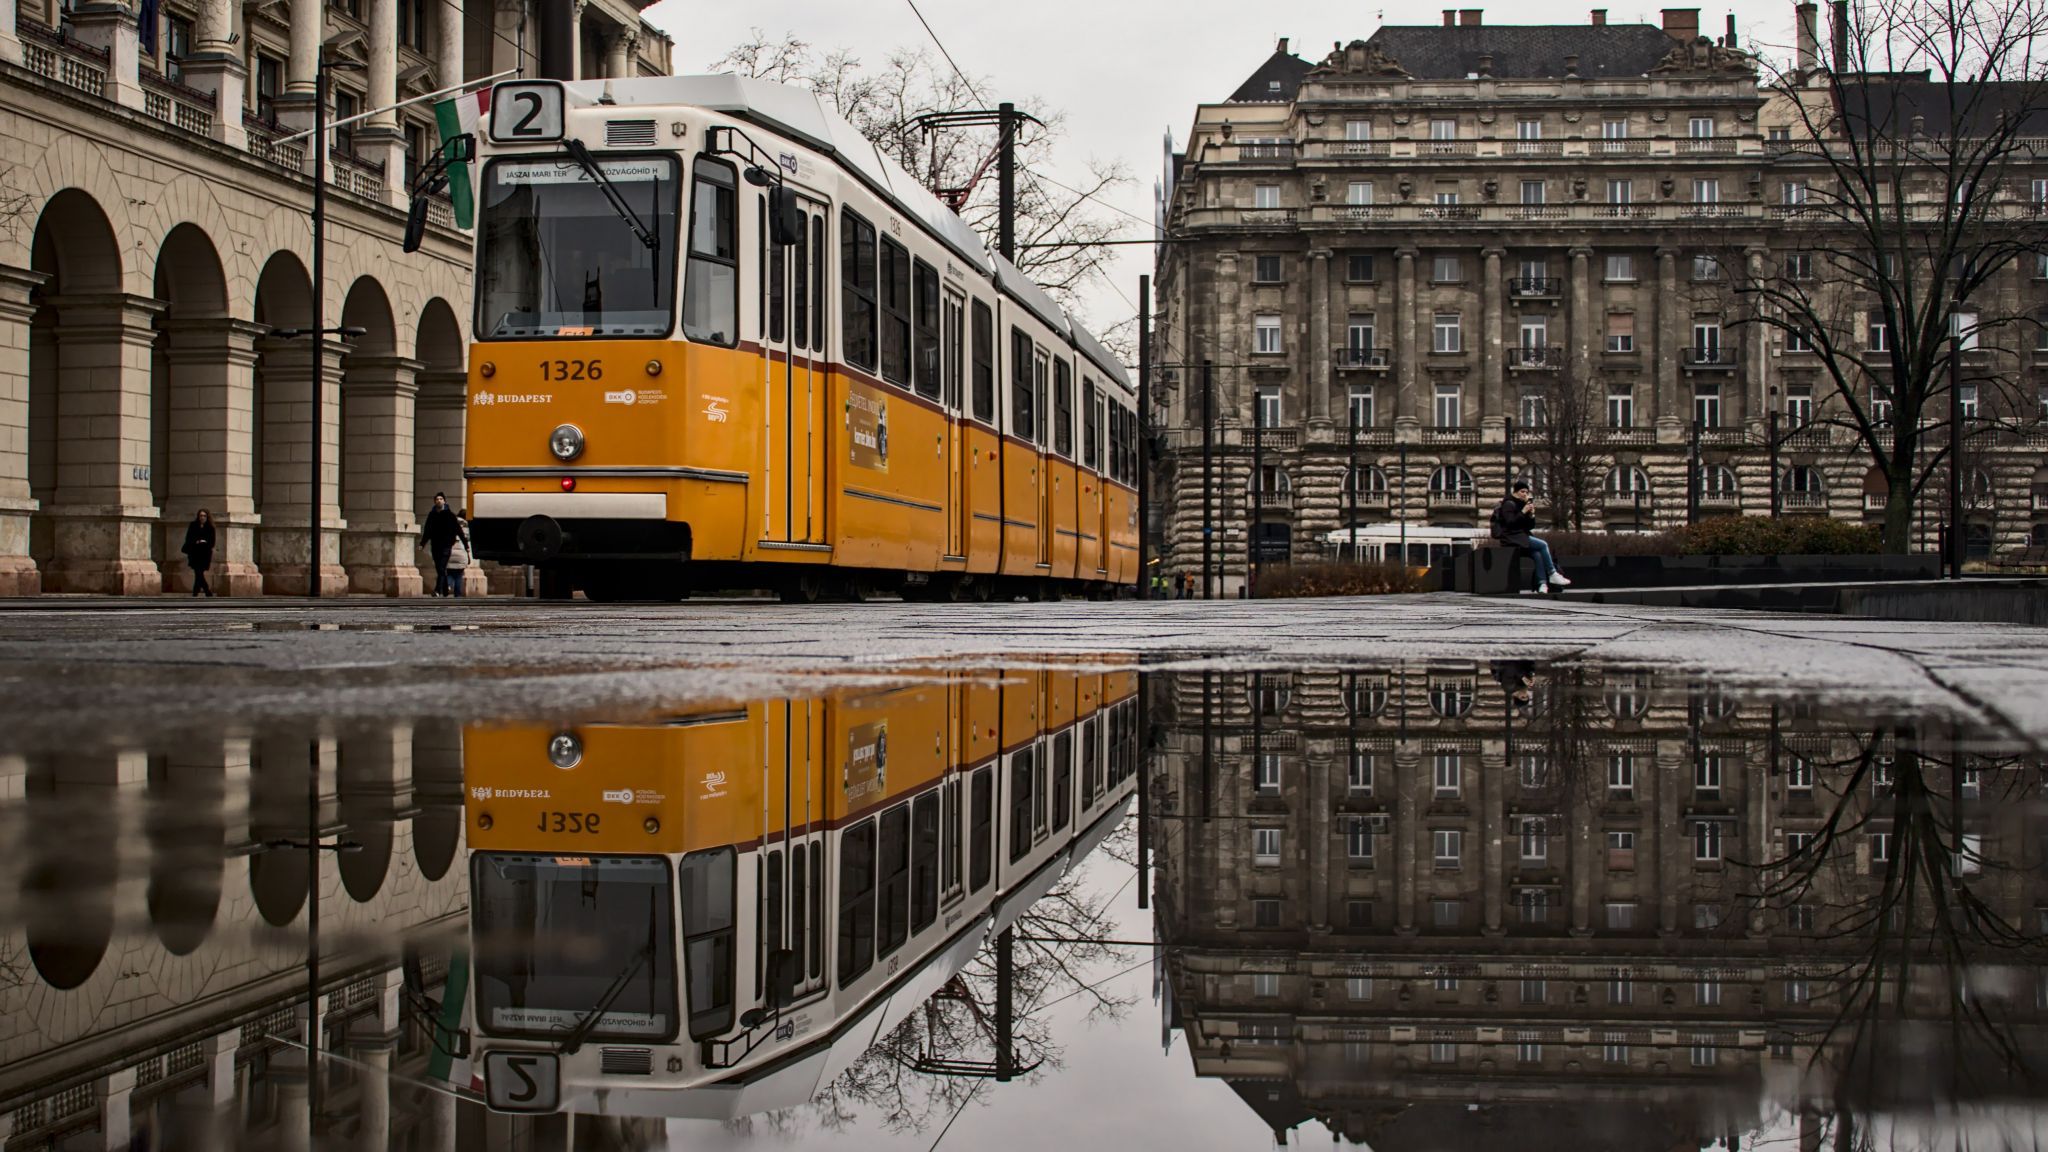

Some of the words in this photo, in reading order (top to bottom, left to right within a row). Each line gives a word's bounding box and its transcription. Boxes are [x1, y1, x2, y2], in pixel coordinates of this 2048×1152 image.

[512, 91, 543, 136] 2
[532, 170, 551, 178] MARI
[889, 216, 902, 238] 1326
[539, 359, 603, 381] 1326
[497, 394, 553, 403] BUDAPEST
